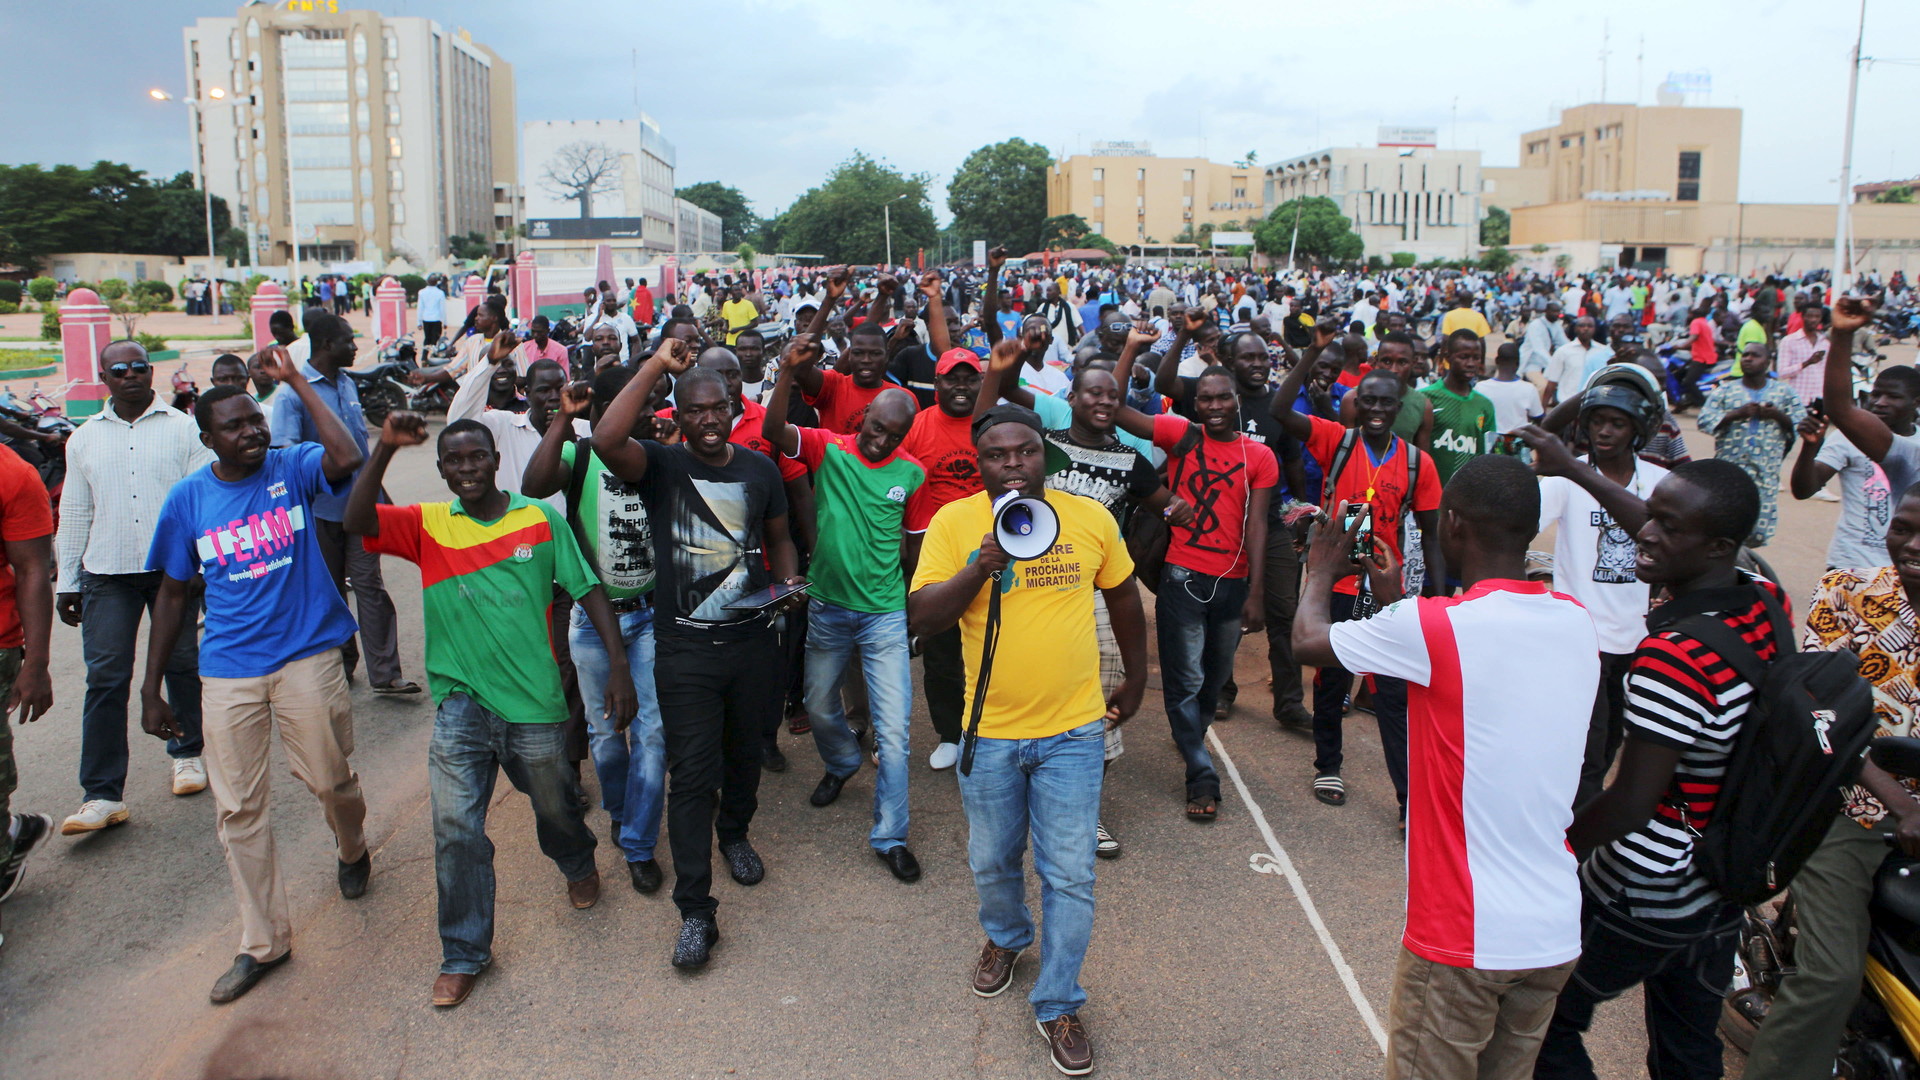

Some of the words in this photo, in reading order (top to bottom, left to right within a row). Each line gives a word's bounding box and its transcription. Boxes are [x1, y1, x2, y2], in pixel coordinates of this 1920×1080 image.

[288, 0, 338, 13] CNSS
[204, 506, 294, 566] TEAM
[1025, 562, 1080, 577] PROCHAINE
[1026, 574, 1080, 589] MIGRATION
